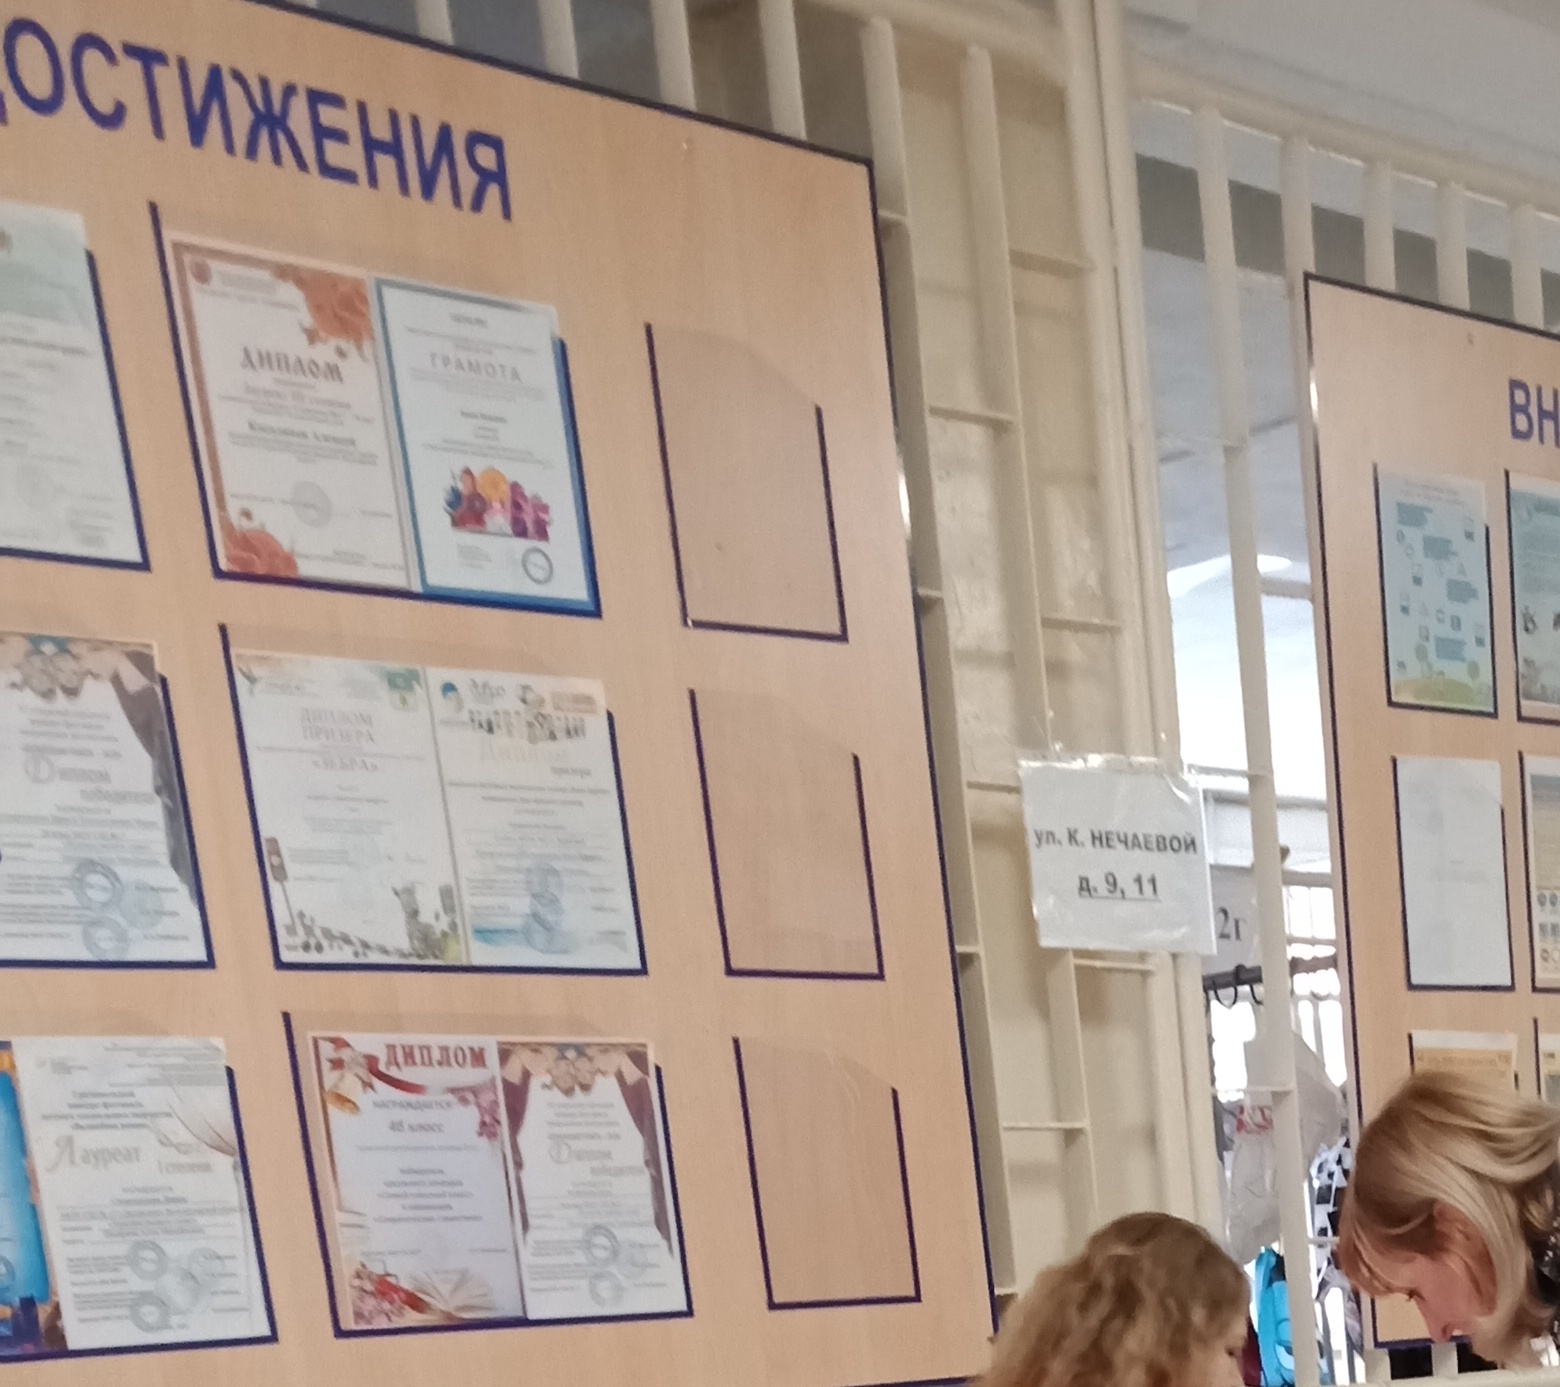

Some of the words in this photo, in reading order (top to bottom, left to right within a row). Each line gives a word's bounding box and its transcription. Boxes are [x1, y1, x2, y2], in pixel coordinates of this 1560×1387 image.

[0, 18, 512, 220] ОСТИЖЕНИЯ
[241, 346, 344, 383] ДИПЛОМ
[429, 352, 523, 383] ГРАМОТА
[1033, 829, 1063, 849] ул.
[1067, 828, 1085, 847] К.
[1090, 828, 1198, 854] НЕЧАЕВОЙ
[1134, 873, 1159, 897] 11
[384, 1043, 488, 1072] ДИПЛОМ
